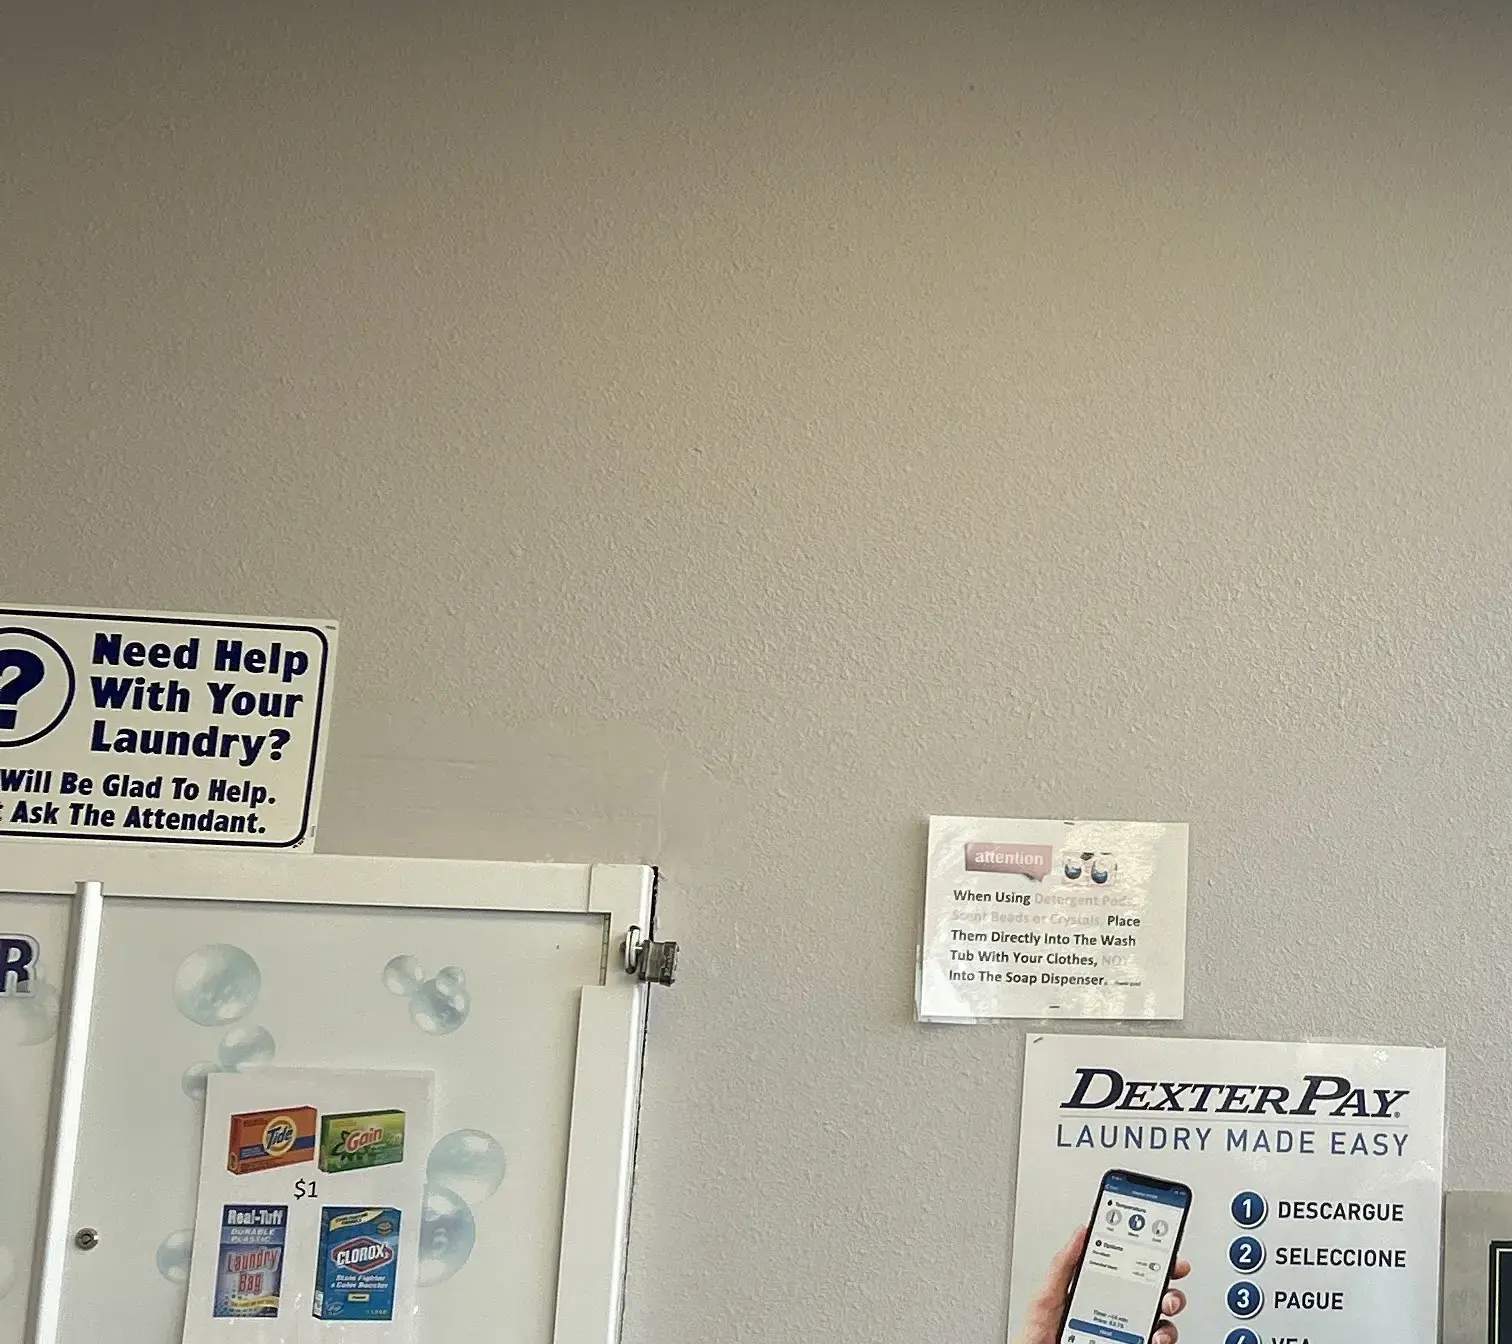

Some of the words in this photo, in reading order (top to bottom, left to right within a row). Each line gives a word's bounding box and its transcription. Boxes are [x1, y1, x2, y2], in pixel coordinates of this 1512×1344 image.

[92, 632, 200, 670] Need
[214, 640, 308, 682] Help
[90, 676, 191, 713] With
[207, 682, 304, 717] Your
[91, 720, 291, 767] Laundry?
[0, 769, 52, 793] Will
[60, 772, 93, 795] Be
[102, 774, 162, 799] Glad
[171, 777, 199, 801] To
[208, 779, 276, 809] Help.
[10, 800, 59, 825] Ask
[69, 802, 115, 827] The
[123, 805, 266, 833] Attendant.
[974, 850, 1044, 866] attention
[953, 889, 992, 903] When
[995, 891, 1031, 905] Using
[1107, 916, 1141, 928] Place
[950, 929, 987, 942] Them
[991, 931, 1041, 946] Directly
[1044, 933, 1070, 945] Into
[1073, 934, 1097, 946] The
[1100, 935, 1136, 947] Wash
[950, 949, 974, 962] Tub
[978, 951, 1009, 963] With
[1013, 952, 1043, 964] Your
[1046, 953, 1098, 967] Clothes,
[949, 970, 975, 982] Into
[978, 971, 1002, 983] The
[1005, 972, 1037, 986] Soap
[1041, 973, 1108, 987] Dispenser.
[266, 1126, 293, 1149] Tide
[346, 1128, 382, 1151] Gain
[1056, 1124, 1212, 1151] LAUNDRY
[1227, 1129, 1315, 1154] MADE
[1331, 1132, 1409, 1156] EASY
[293, 1178, 319, 1200] $1
[1242, 1198, 1251, 1218] 1
[1278, 1201, 1404, 1222] DESCARGUE
[227, 1249, 278, 1272] Laundry
[1239, 1244, 1252, 1263] 2
[1276, 1247, 1406, 1268] SELECCIONE
[239, 1273, 263, 1295] Bag
[1237, 1288, 1250, 1308] 3
[1274, 1291, 1344, 1310] PAGUE
